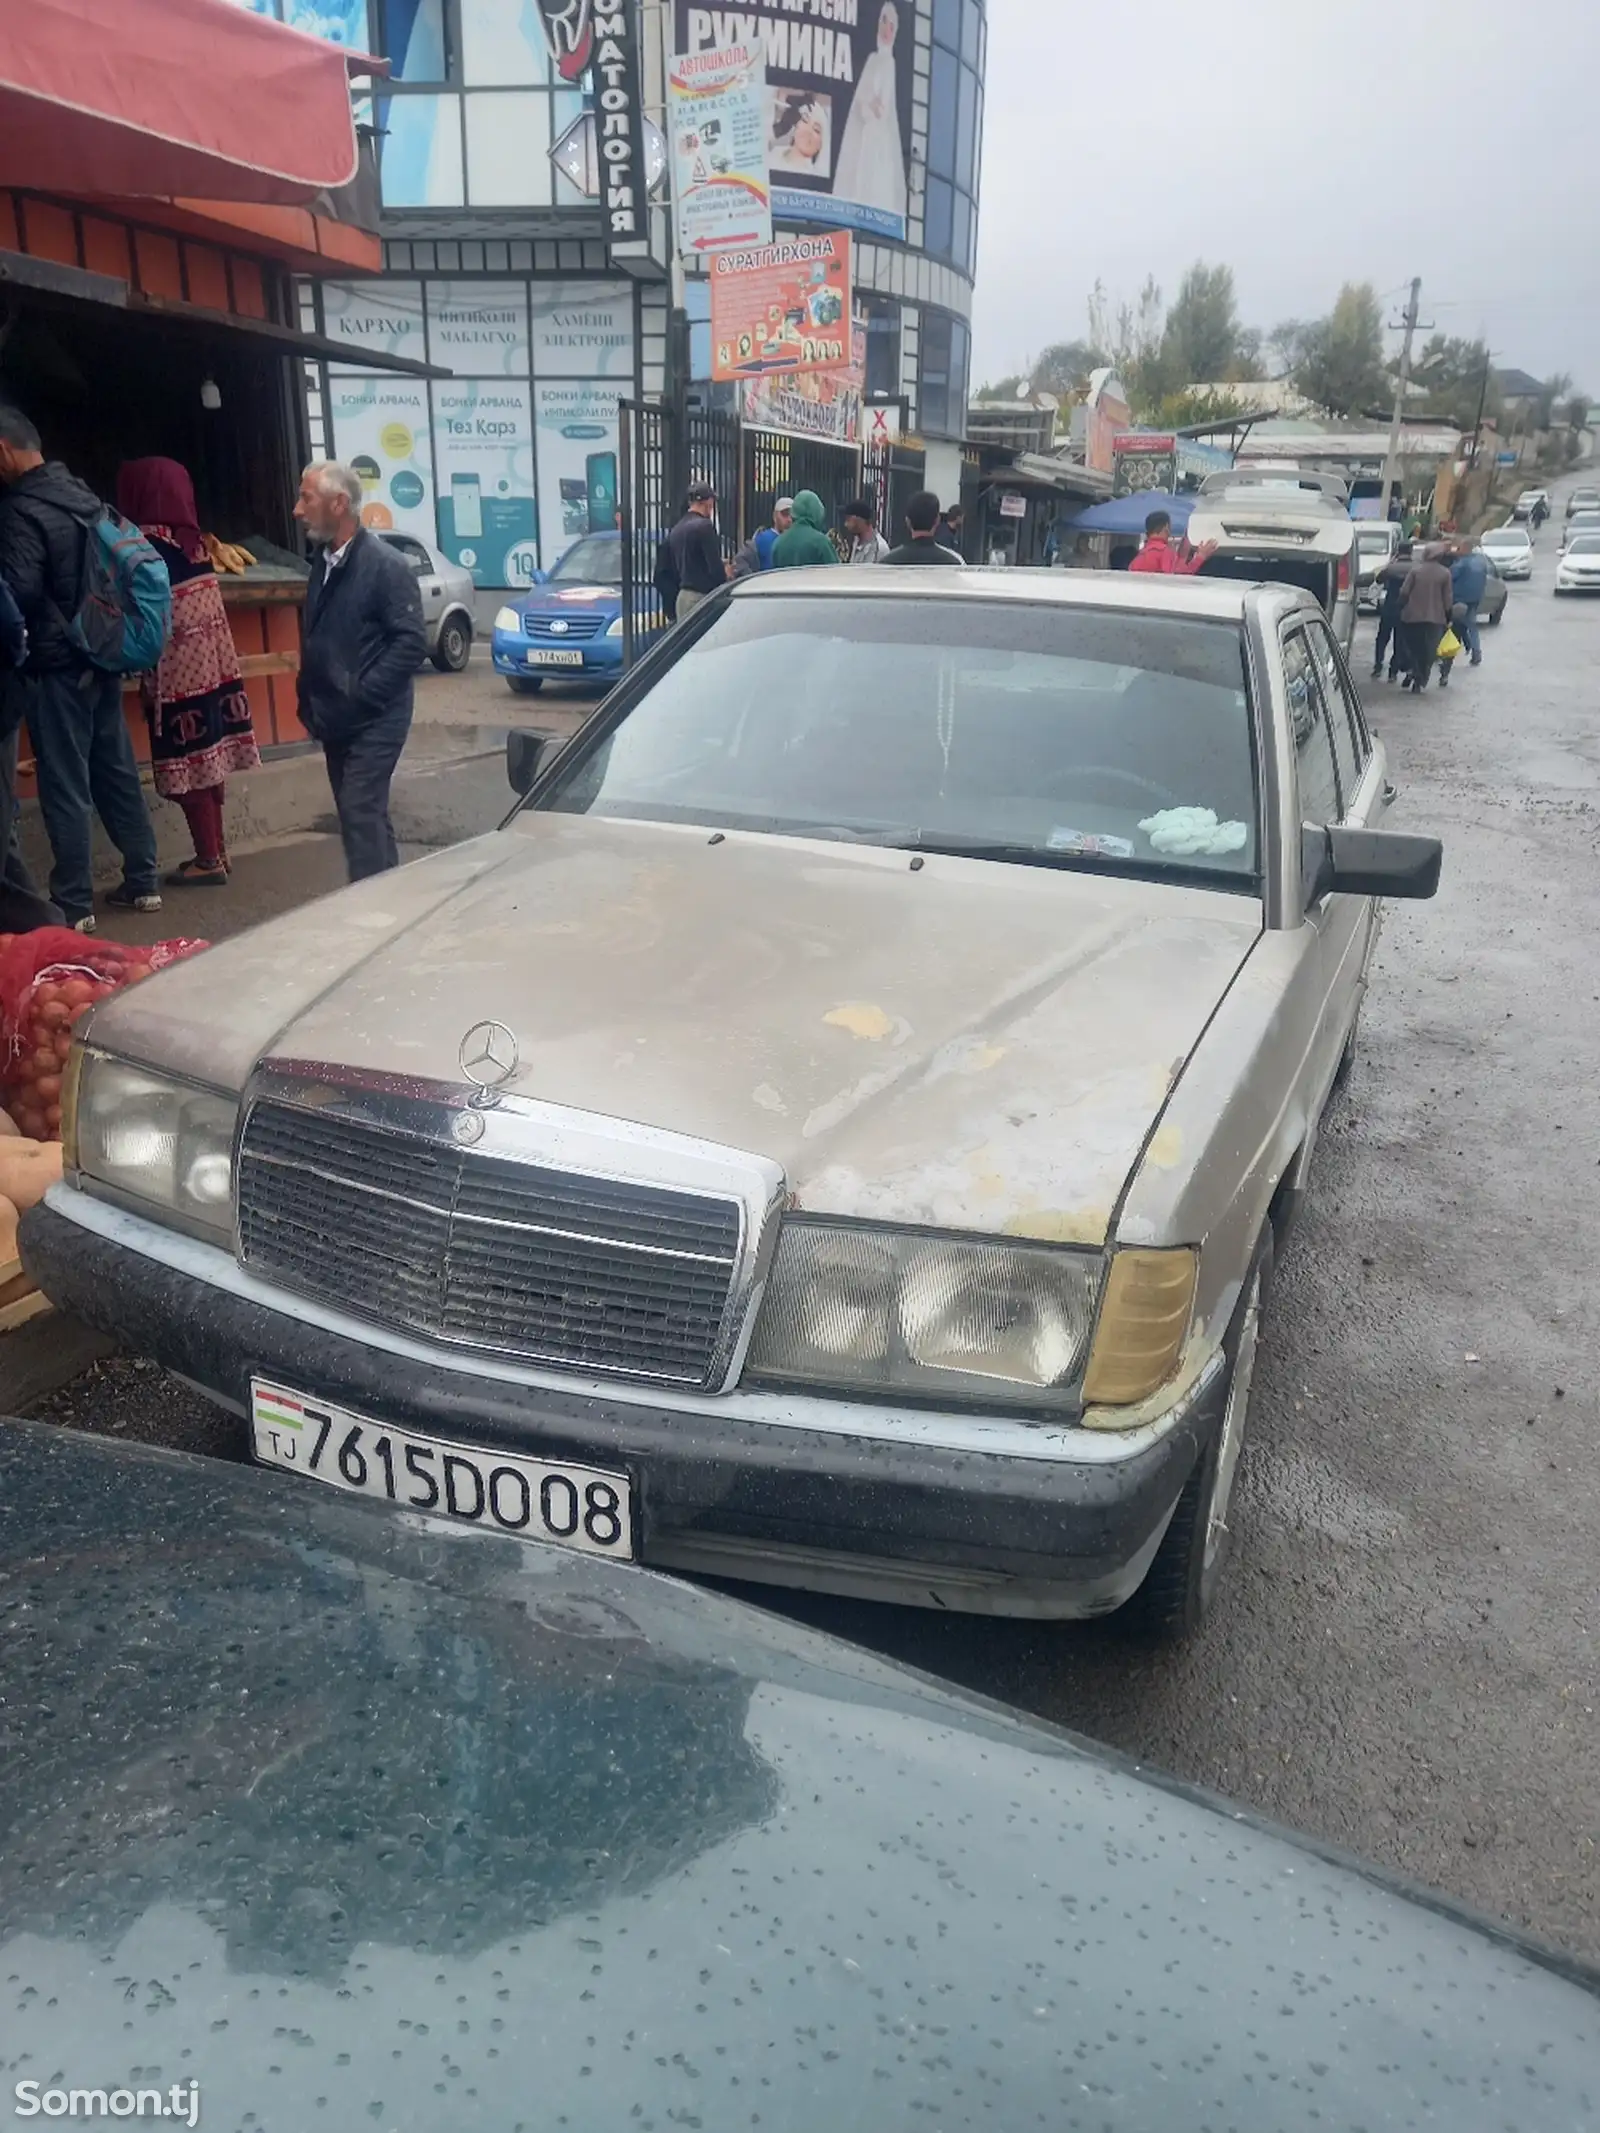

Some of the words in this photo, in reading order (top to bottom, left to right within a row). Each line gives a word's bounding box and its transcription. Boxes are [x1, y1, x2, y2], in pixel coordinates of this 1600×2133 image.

[678, 45, 749, 77] АВТОШКОЛА
[717, 236, 835, 275] СУРАТГИРХОНА
[341, 395, 377, 406] БОНКИ
[378, 395, 421, 407] АРВАНД
[441, 397, 478, 408] БОНКИ
[479, 397, 523, 409] АРВАНД
[541, 389, 578, 402] БОНКИ
[446, 418, 473, 434] Тез
[511, 551, 534, 576] 10
[268, 1430, 296, 1460] TJ
